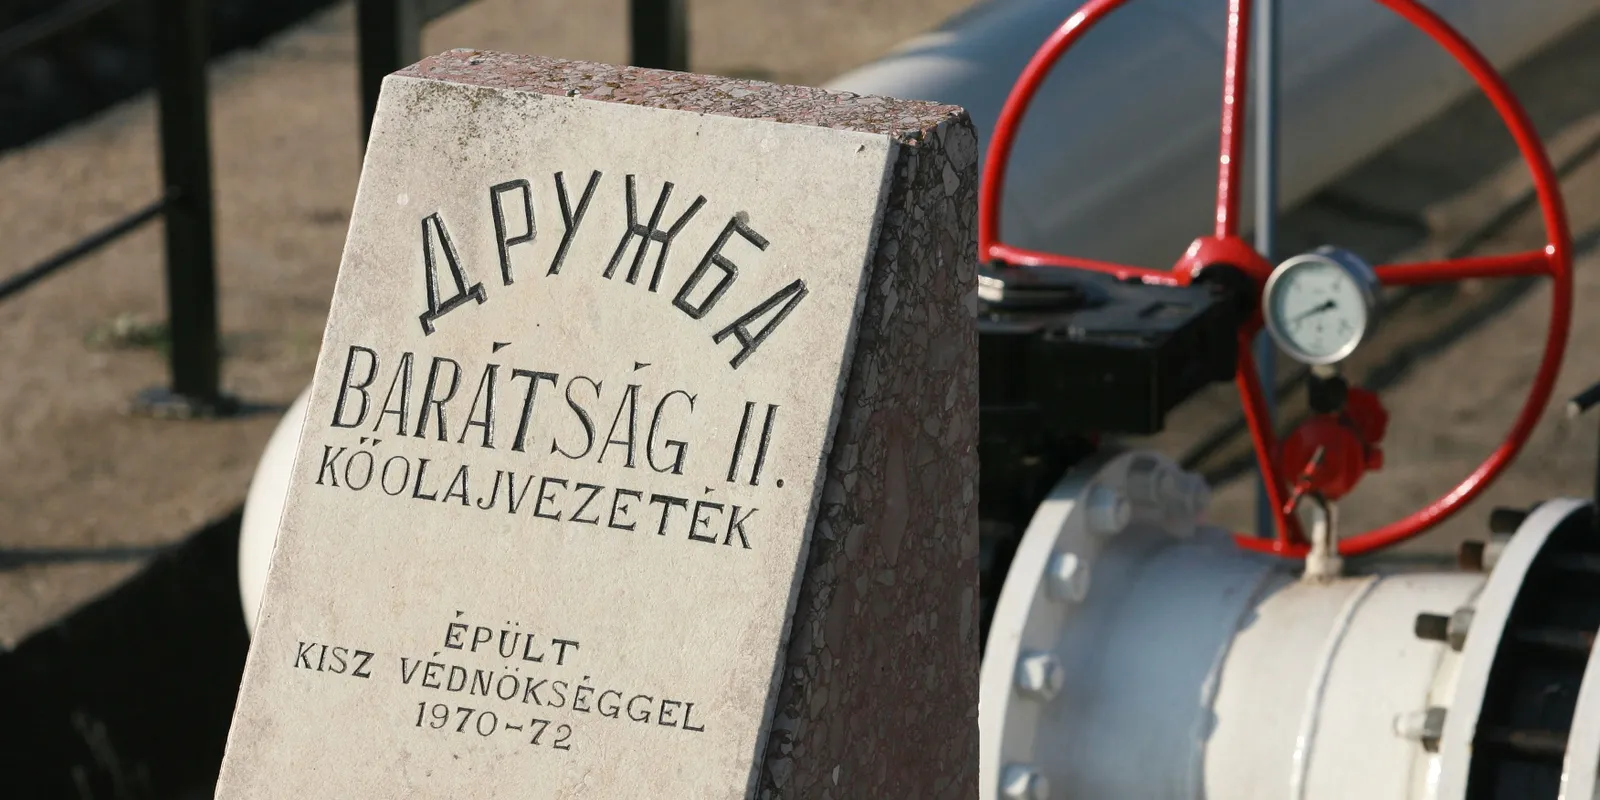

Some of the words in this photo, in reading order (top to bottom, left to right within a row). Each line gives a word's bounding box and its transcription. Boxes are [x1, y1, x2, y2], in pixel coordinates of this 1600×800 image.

[418, 169, 810, 370] ДРУЖБА
[330, 341, 698, 476] BARÁTSÁG
[725, 400, 786, 489] II.
[315, 437, 761, 550] KŐOLAJVEZETÉK
[293, 641, 376, 679] KISZ
[399, 651, 706, 733] VÉDNÖKSÉGGEL
[443, 610, 580, 666] ÉPÜLT
[414, 701, 573, 751] 1970-72
